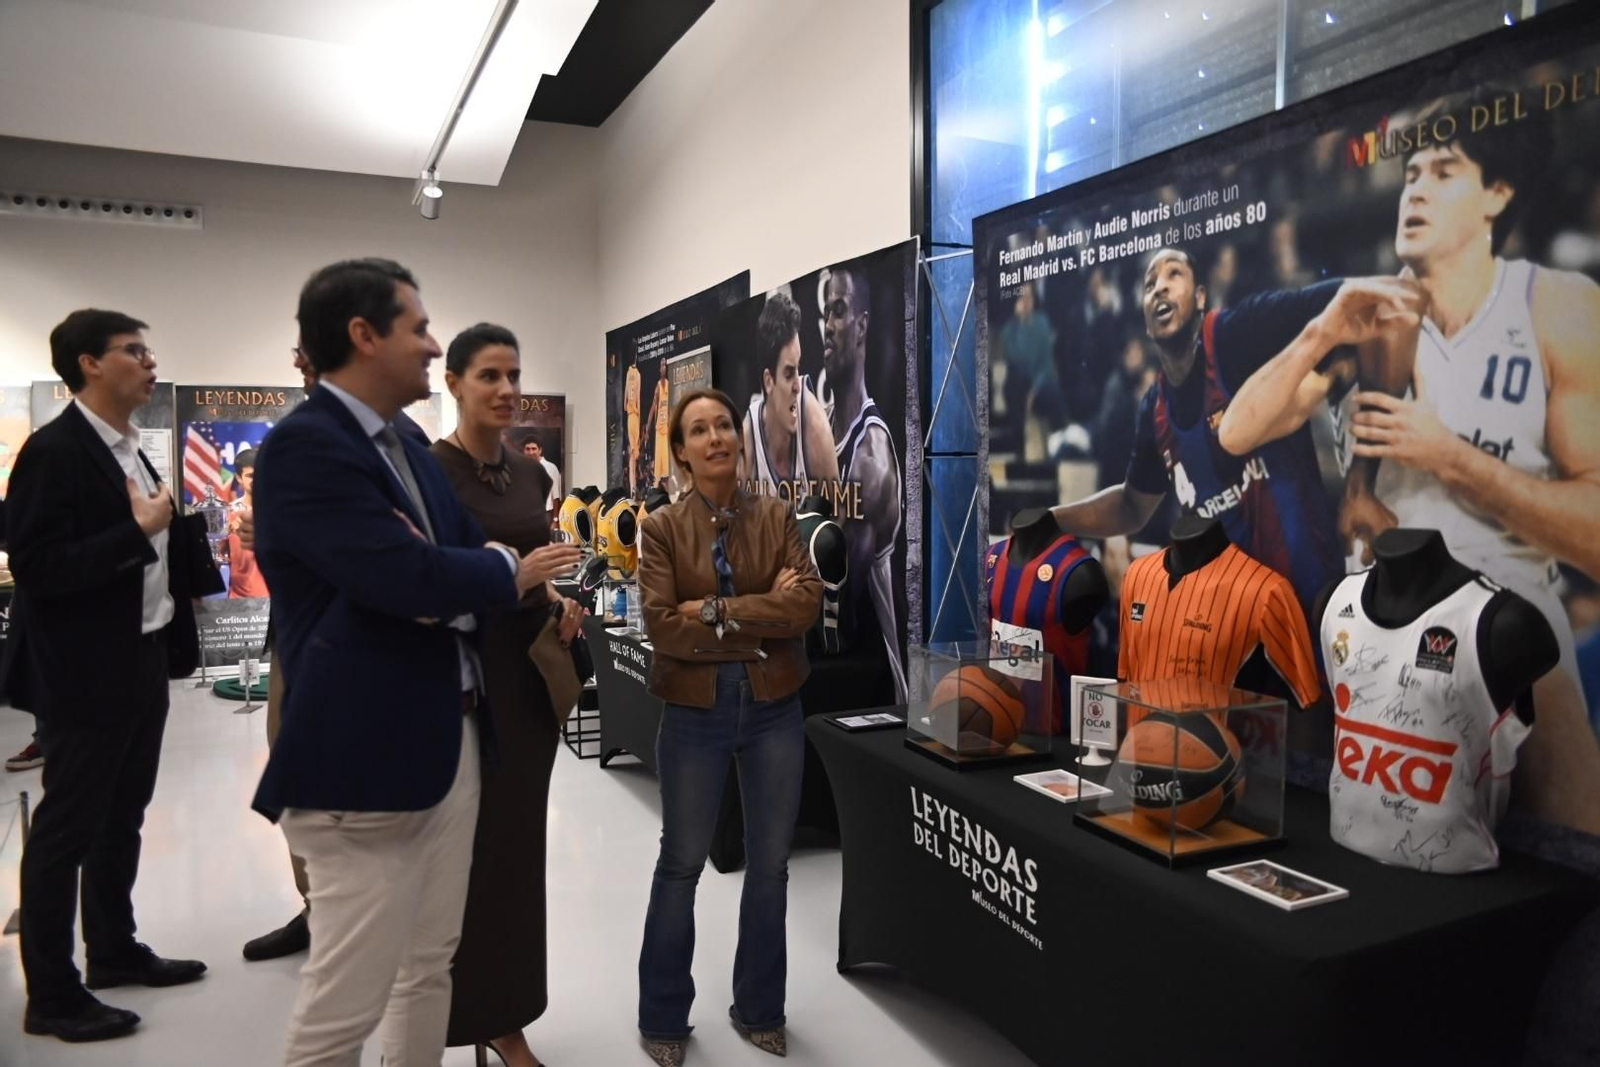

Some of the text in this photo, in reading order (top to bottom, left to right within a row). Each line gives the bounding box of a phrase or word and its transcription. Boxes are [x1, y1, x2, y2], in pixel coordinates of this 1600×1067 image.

[1348, 113, 1457, 168] MUSEO
[1470, 91, 1528, 133] DEL
[999, 184, 1240, 267] Fernando Martín y Audie Norris durante un
[1000, 201, 1267, 288] Real Madrid vs. FC Barcelona de los años 80
[195, 390, 286, 406] LEYENDAS
[1479, 354, 1532, 405] 10
[216, 616, 248, 624] Carlitos
[608, 640, 646, 668] HALL OF FAME
[1088, 692, 1104, 701] NO
[910, 785, 1038, 893] LEYENDAS
[913, 821, 1038, 925] DEL DEPORTE
[971, 889, 1043, 950] MUSEO DEL DEPORTE
